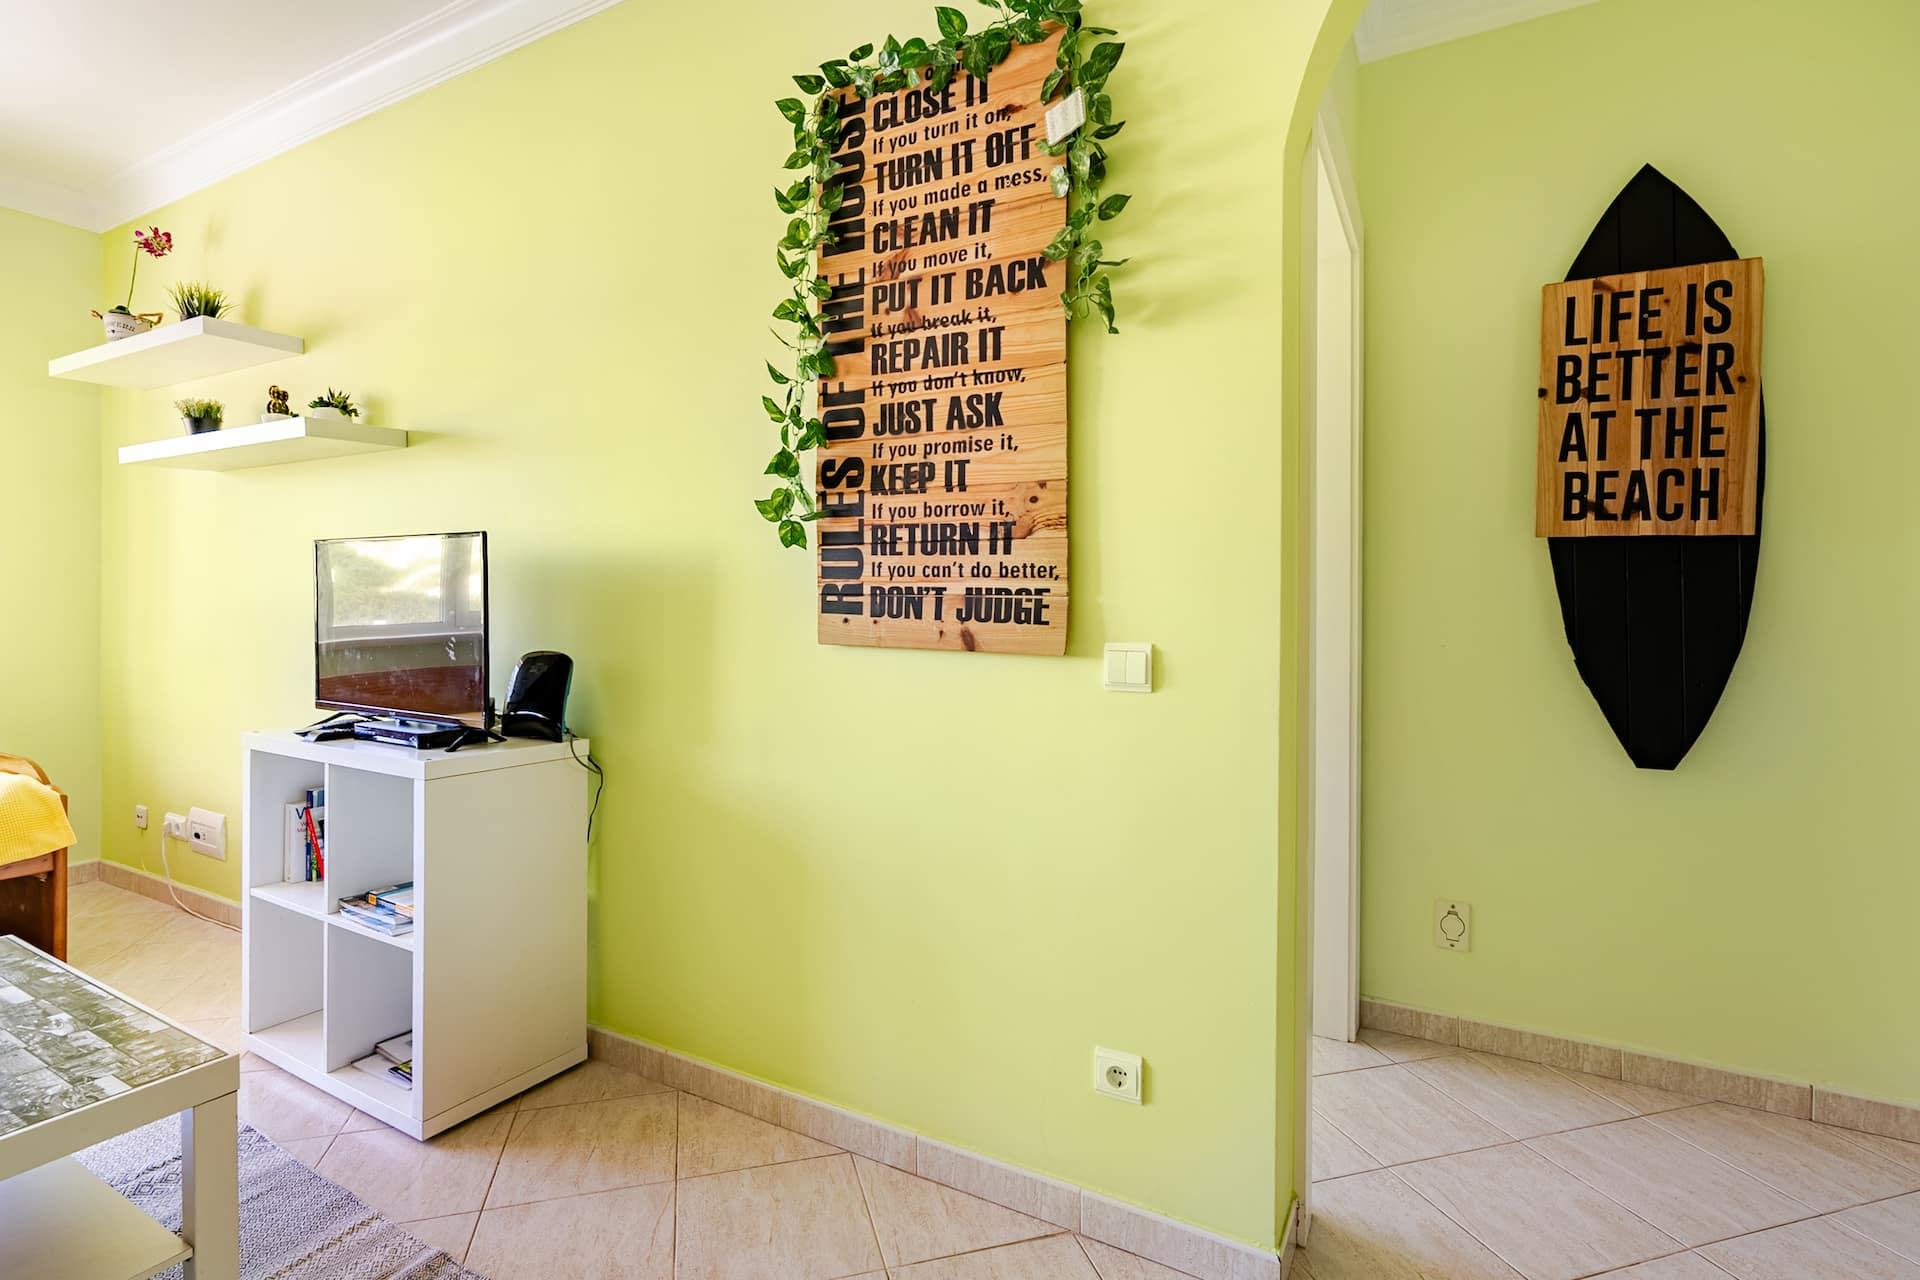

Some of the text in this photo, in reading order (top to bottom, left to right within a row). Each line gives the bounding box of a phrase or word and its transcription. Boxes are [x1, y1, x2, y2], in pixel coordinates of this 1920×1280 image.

[873, 78, 957, 133] CLOSE
[966, 65, 993, 107] IT
[872, 107, 1011, 155] If you turn it on,
[821, 91, 866, 258] HOUSE
[873, 122, 1036, 194] TURN IT OFF
[872, 167, 1047, 217] If you made a mess,
[873, 198, 996, 255] CLEAN IT
[872, 242, 992, 280] If you move it,
[872, 256, 1048, 316] PUT IT BACK
[871, 306, 997, 339] If you break it,
[1564, 279, 1734, 347] LIFE IS
[871, 326, 1006, 376] REPAIR IT
[1555, 342, 1736, 405] BETTER
[872, 368, 1026, 398] If you don't know,
[822, 382, 866, 441] OF
[872, 391, 1004, 436] JUST ASK
[1558, 404, 1728, 463] AT THE
[872, 433, 1019, 462] If you promise it,
[870, 459, 971, 496] KEEP IT
[1562, 467, 1721, 522] BEACH
[872, 498, 1010, 522] If you borrow it,
[820, 457, 865, 615] RULES
[870, 520, 1017, 556] RETURN IT
[871, 561, 1060, 581] If you can't do better,
[870, 585, 1052, 625] DON'T JUDGE
